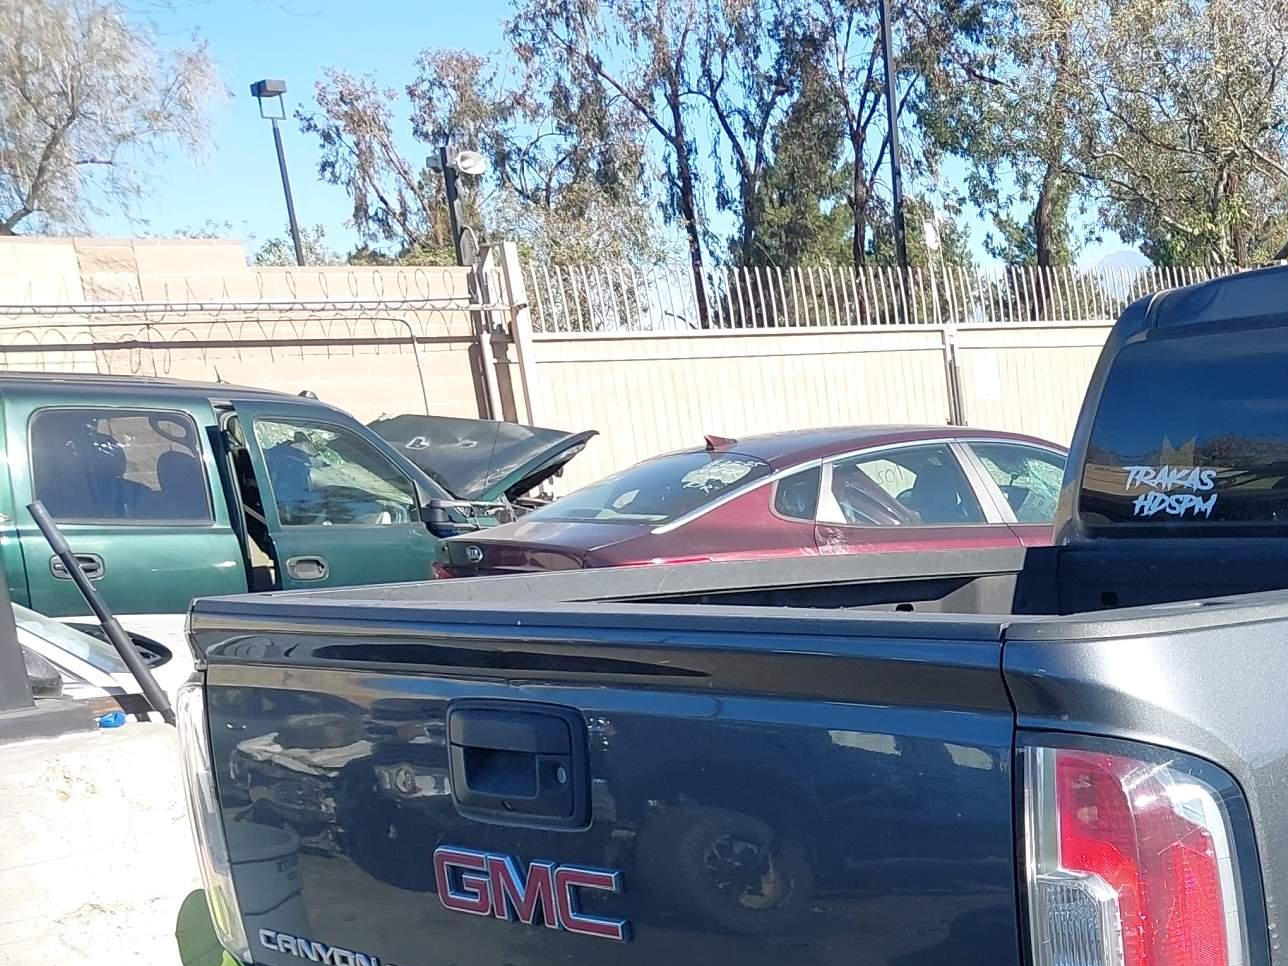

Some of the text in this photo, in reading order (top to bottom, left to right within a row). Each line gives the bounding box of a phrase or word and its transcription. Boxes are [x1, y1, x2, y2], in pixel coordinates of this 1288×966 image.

[1121, 464, 1217, 492] TRAKAS
[1132, 491, 1218, 519] HDSPM
[434, 845, 630, 943] GMC
